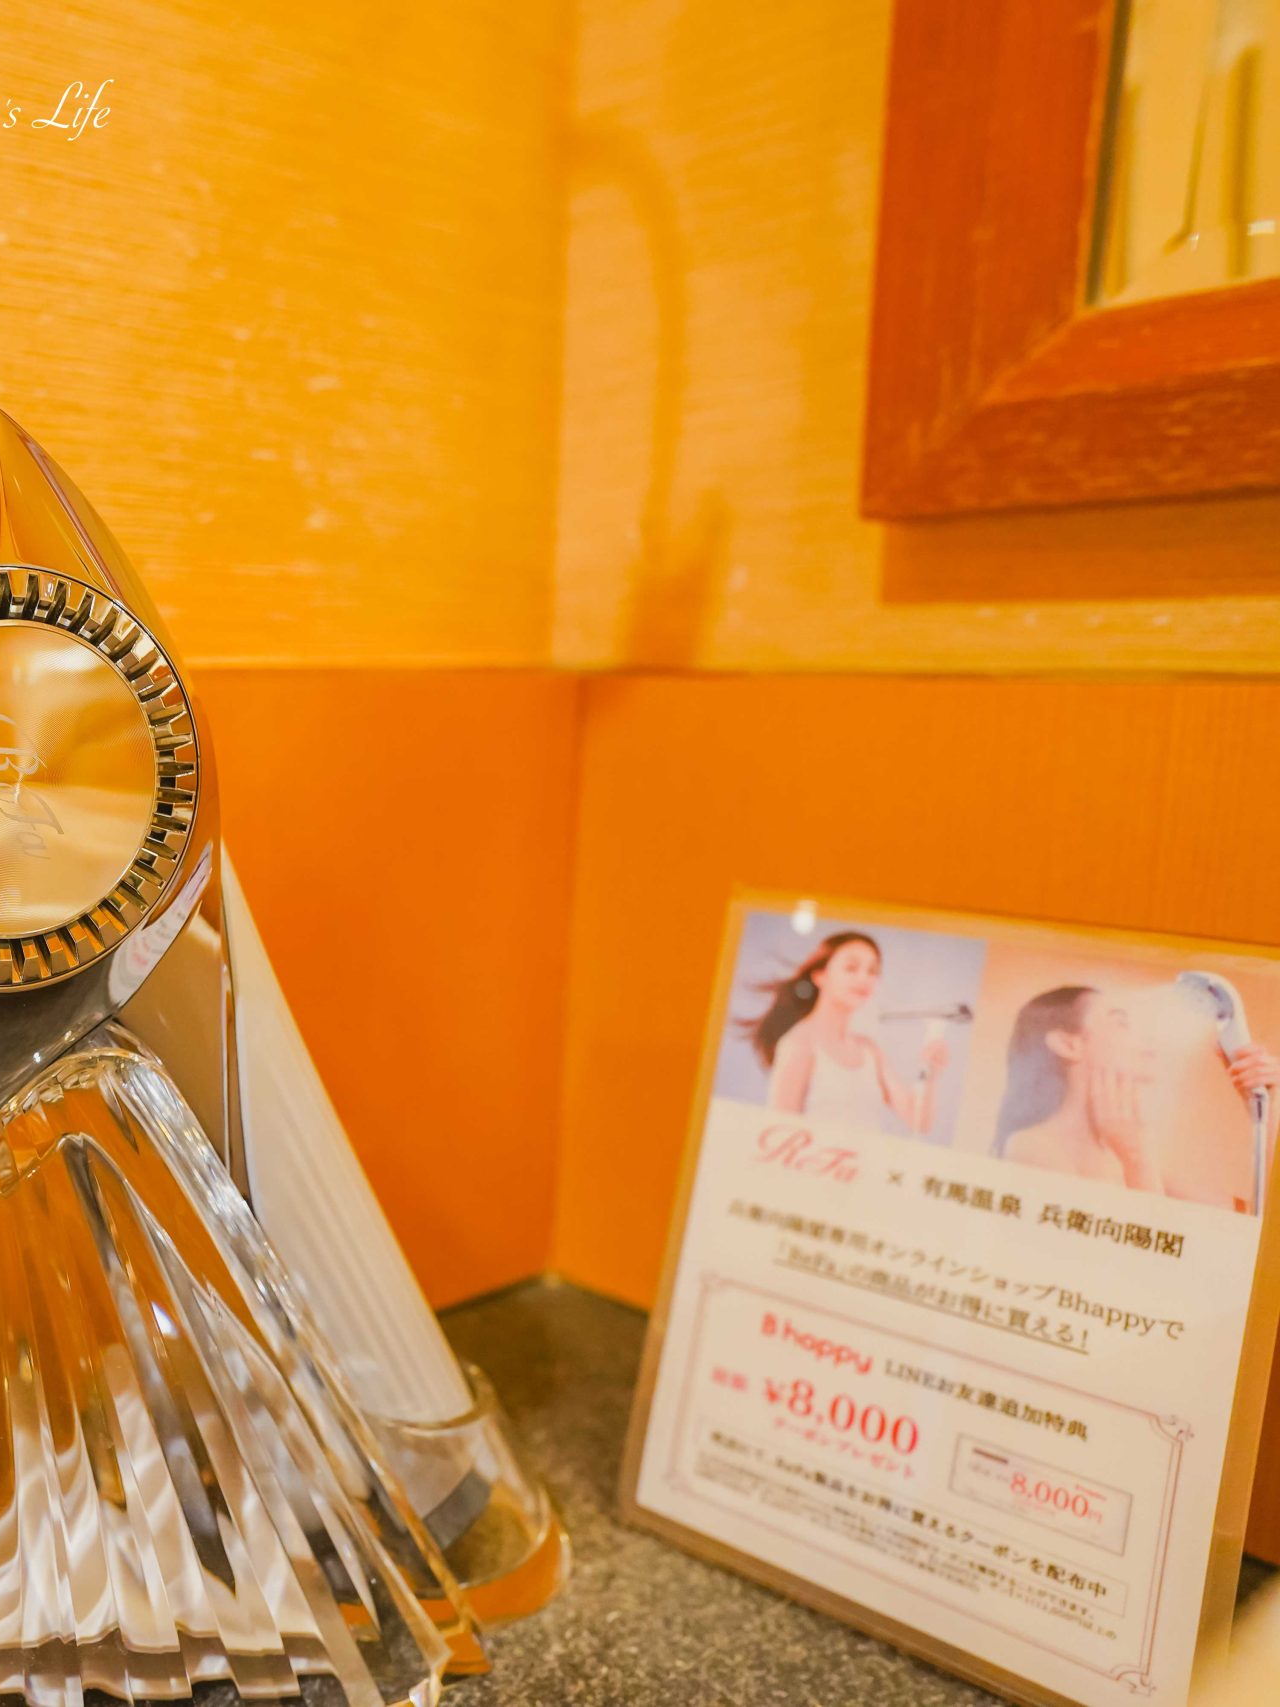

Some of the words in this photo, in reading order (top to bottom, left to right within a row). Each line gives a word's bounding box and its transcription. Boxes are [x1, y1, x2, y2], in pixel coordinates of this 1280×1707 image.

[923, 1174, 1023, 1219] 有馬温泉
[1037, 1203, 1186, 1259] 兵衛向陽閣
